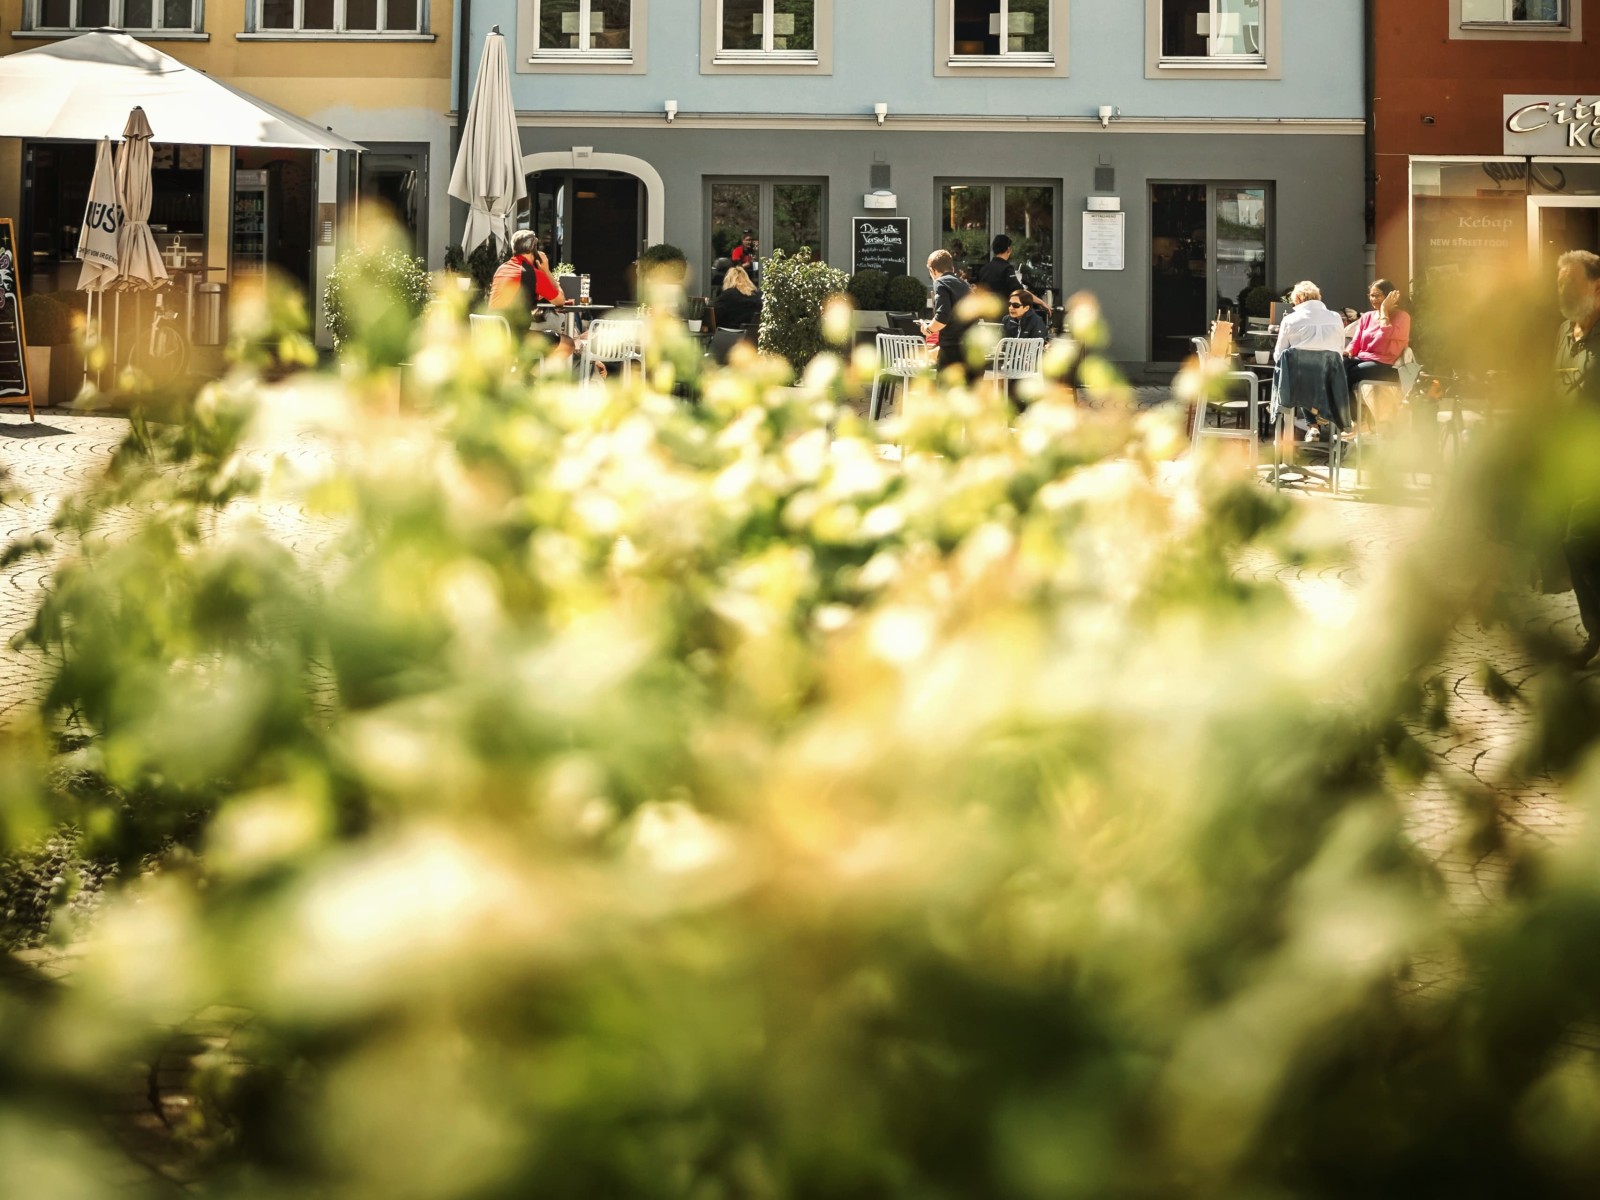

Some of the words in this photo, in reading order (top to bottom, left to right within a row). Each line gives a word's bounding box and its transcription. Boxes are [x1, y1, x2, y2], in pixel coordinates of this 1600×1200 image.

[860, 223, 879, 234] Die
[1457, 215, 1513, 232] Kebap
[1452, 239, 1482, 247] STREET
